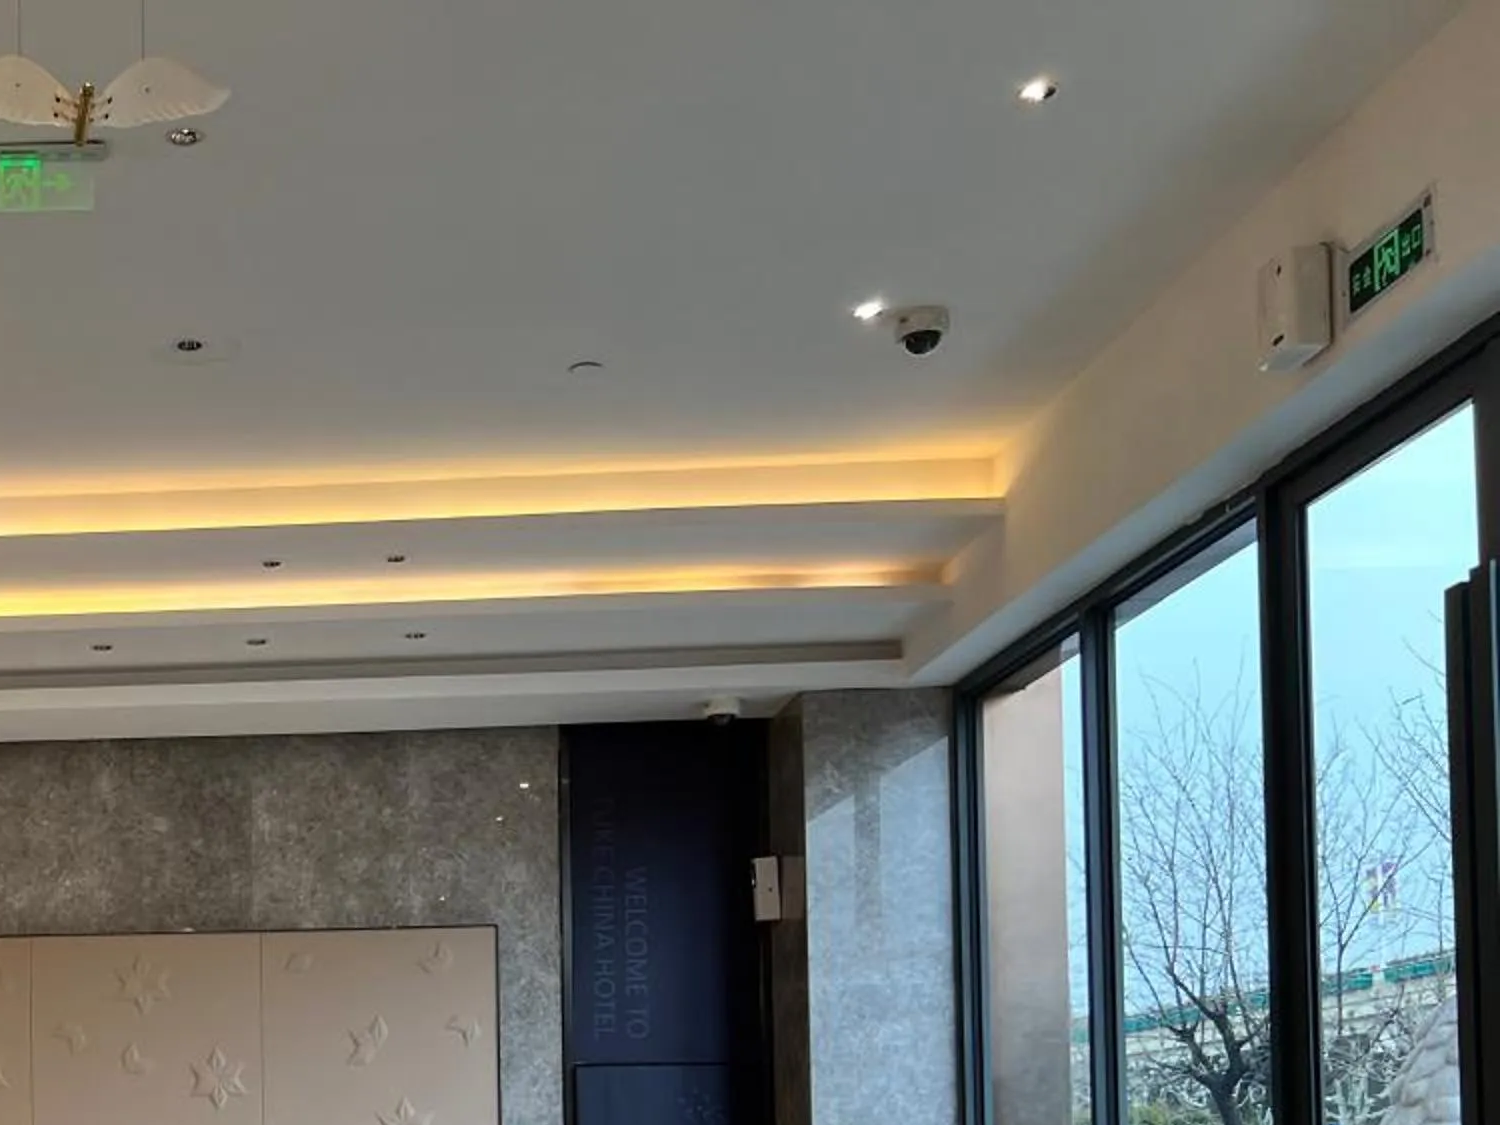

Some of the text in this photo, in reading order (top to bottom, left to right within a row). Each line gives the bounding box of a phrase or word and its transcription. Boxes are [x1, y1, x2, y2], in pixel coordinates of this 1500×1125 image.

[592, 865, 616, 951] CHINA
[624, 865, 650, 1040] WELCOME TO
[592, 959, 617, 1040] HOTEL
